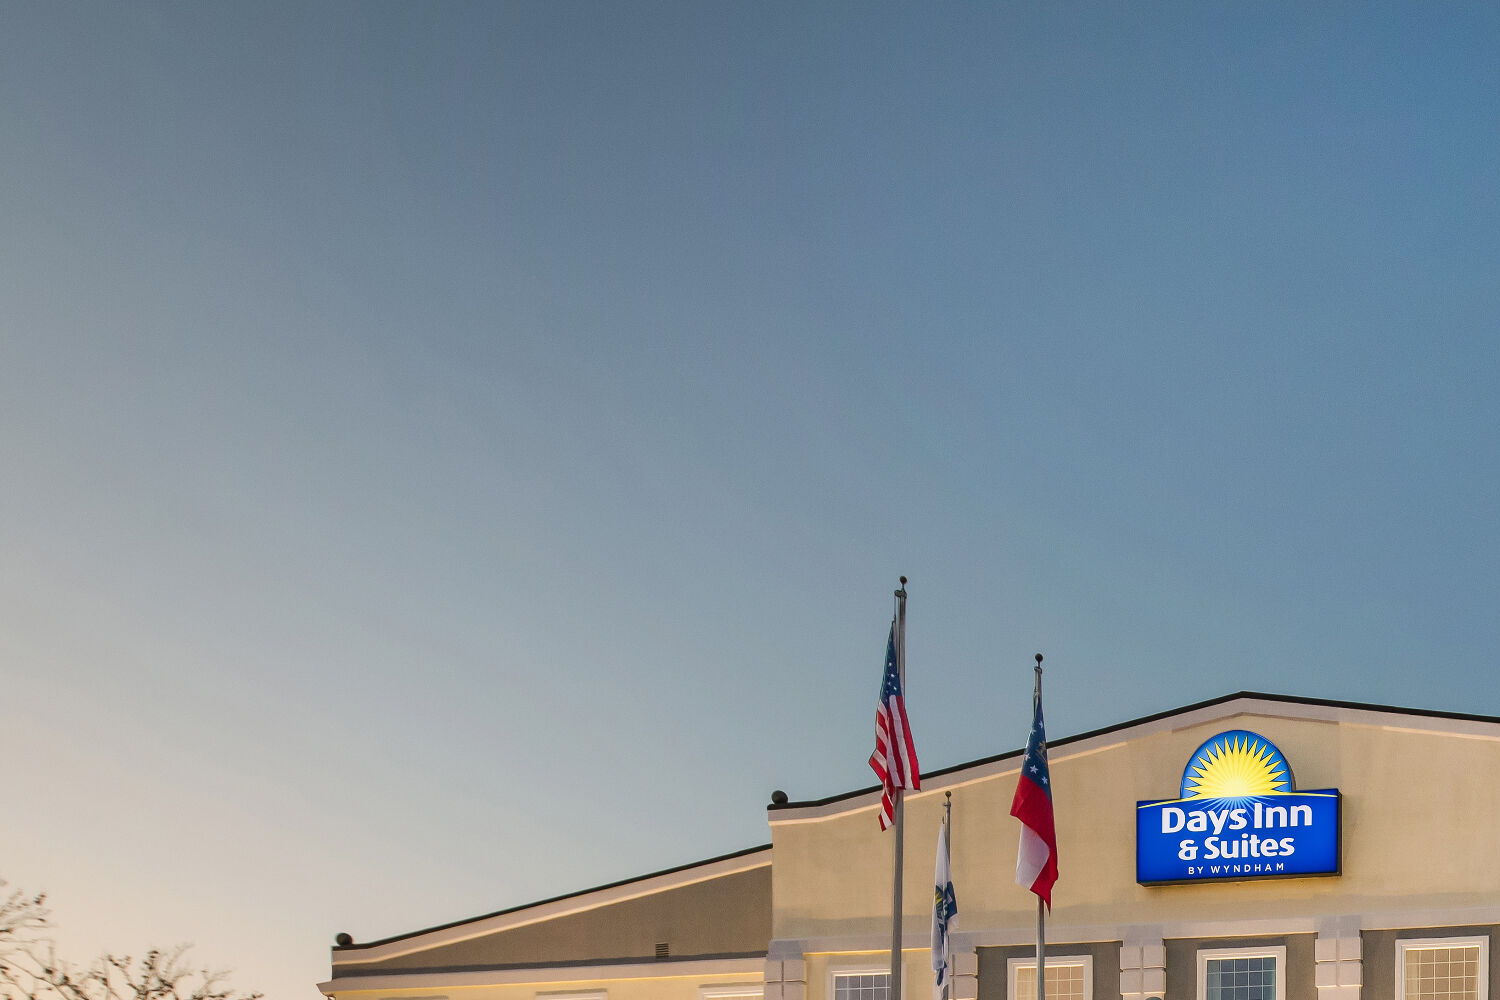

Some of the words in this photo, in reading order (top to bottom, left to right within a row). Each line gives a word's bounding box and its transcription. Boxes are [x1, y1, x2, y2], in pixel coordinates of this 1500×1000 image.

[1161, 807, 1247, 835] Days
[1254, 802, 1312, 829] Inn
[1178, 839, 1198, 860] &
[1203, 833, 1295, 859] Suites
[1188, 866, 1204, 875] BY
[1211, 862, 1284, 873] WYNDHAM
